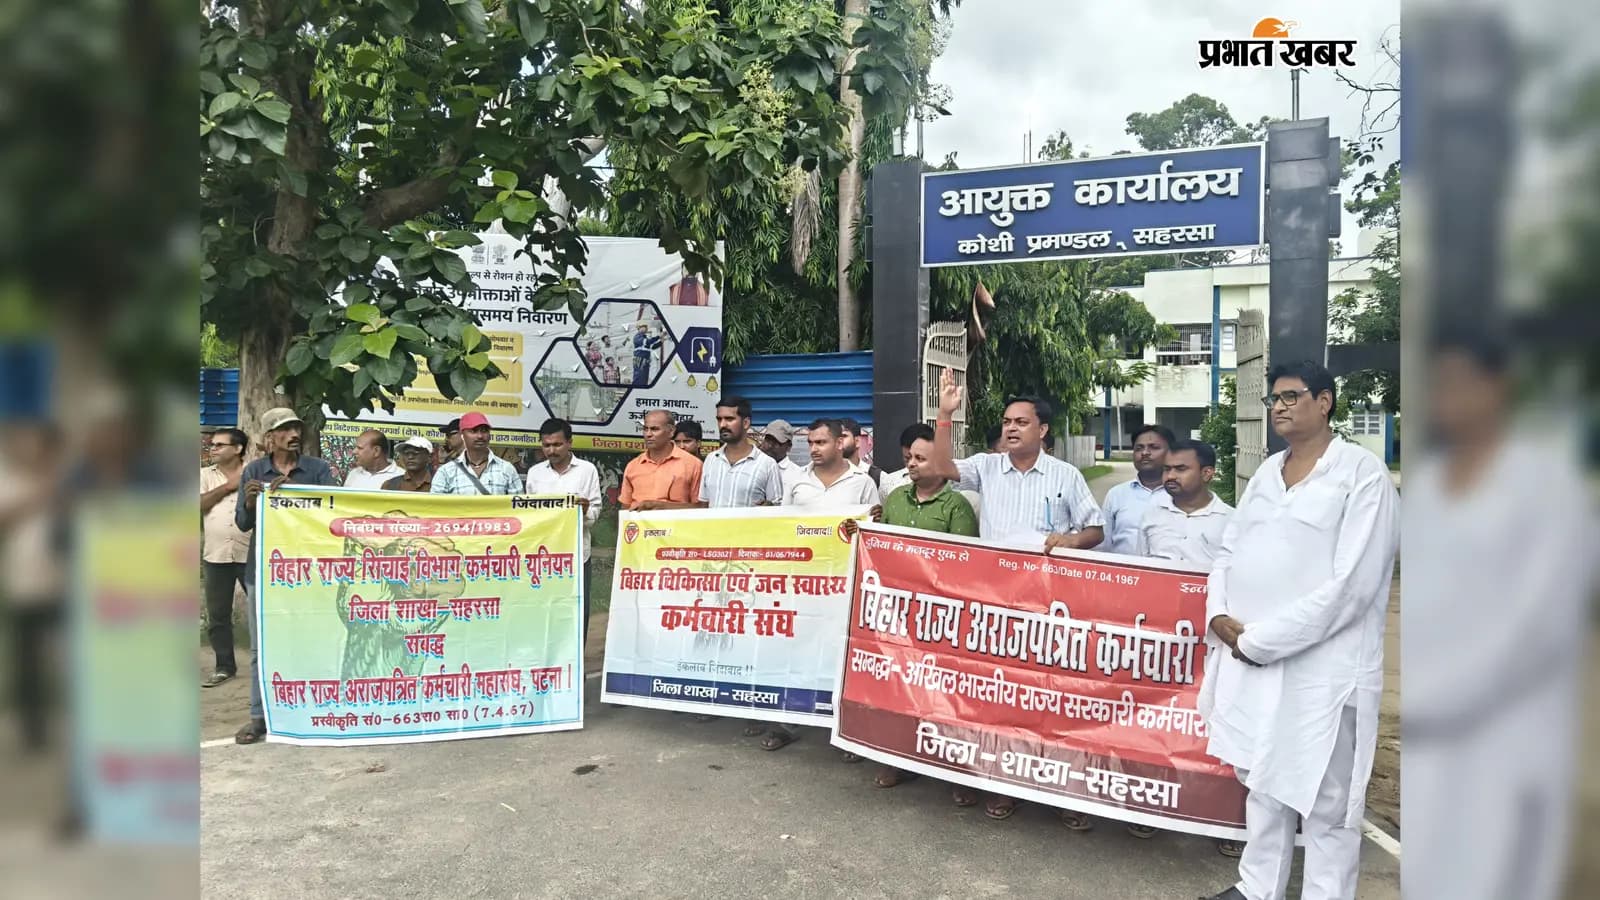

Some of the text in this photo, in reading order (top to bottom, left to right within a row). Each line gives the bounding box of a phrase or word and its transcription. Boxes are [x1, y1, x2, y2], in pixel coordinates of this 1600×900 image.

[938, 160, 1244, 227] आयुक्त कार्यालय
[957, 230, 1015, 255] कोशी
[1132, 223, 1217, 247] सहरसा
[517, 308, 569, 325] निवारण
[635, 398, 660, 409] हमारा
[592, 437, 622, 449] जिला
[343, 519, 384, 534] निबंधन
[433, 520, 512, 534] 2694/1983
[269, 544, 575, 589] बिहार राज्य सिंचाई विभाग कर्मचारी यूनियन
[937, 549, 957, 562] एक
[958, 550, 970, 563] हो
[620, 567, 657, 591] बिहार
[658, 567, 724, 593] चिकित्सा
[725, 567, 754, 594] एवं
[754, 573, 787, 595] जन
[998, 558, 1020, 571] Reg.
[1085, 569, 1141, 587] 07.04.1967
[348, 594, 390, 623] जिला
[660, 598, 798, 638] कर्मचारी संघ
[858, 570, 914, 638] बिहार
[913, 593, 964, 646] राज्य
[965, 599, 1093, 674] अराजपत्रित
[1095, 612, 1200, 685] कर्मचारी
[404, 629, 447, 658] संबद्ध
[271, 671, 308, 707] बिहार
[309, 679, 341, 707] राज्य
[344, 667, 418, 706] अराजपत्रित
[421, 663, 472, 702] कर्मचारी
[529, 666, 563, 694] पटना
[652, 678, 682, 697] जिला
[683, 683, 719, 699] शाखा
[731, 688, 780, 705] सहरसा
[902, 653, 958, 695] अखिल
[957, 667, 1019, 707] भारतीय
[1019, 687, 1063, 716] राज्य
[1063, 690, 1136, 728] सरकारी
[310, 712, 358, 731] प्रस्वीकृति
[915, 722, 979, 767] जिला
